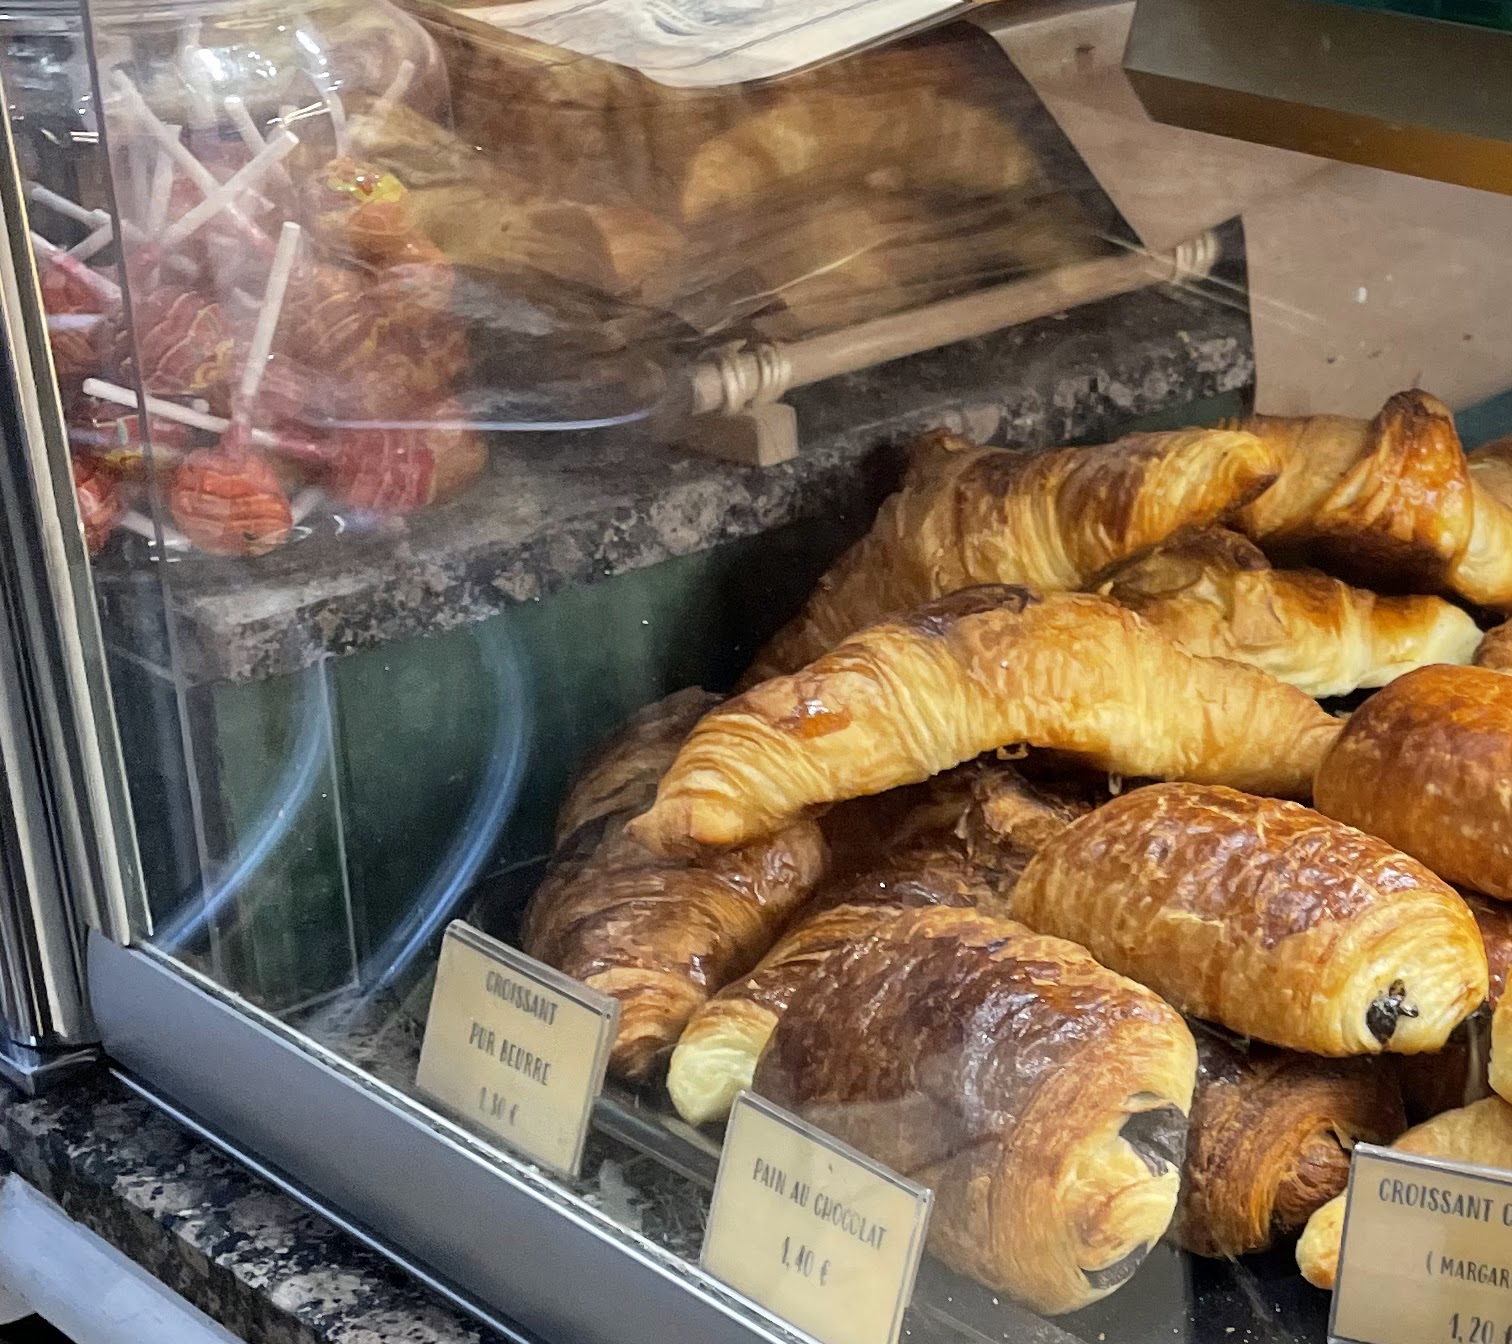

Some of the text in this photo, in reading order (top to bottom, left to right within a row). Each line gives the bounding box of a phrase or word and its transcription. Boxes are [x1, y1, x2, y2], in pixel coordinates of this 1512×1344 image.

[486, 970, 559, 1026] CROISSANT
[469, 1021, 552, 1086] PUR BEURRE
[752, 1157, 888, 1251] PAIN AU CHOCOLAT
[1379, 1177, 1495, 1223] CROISSANT
